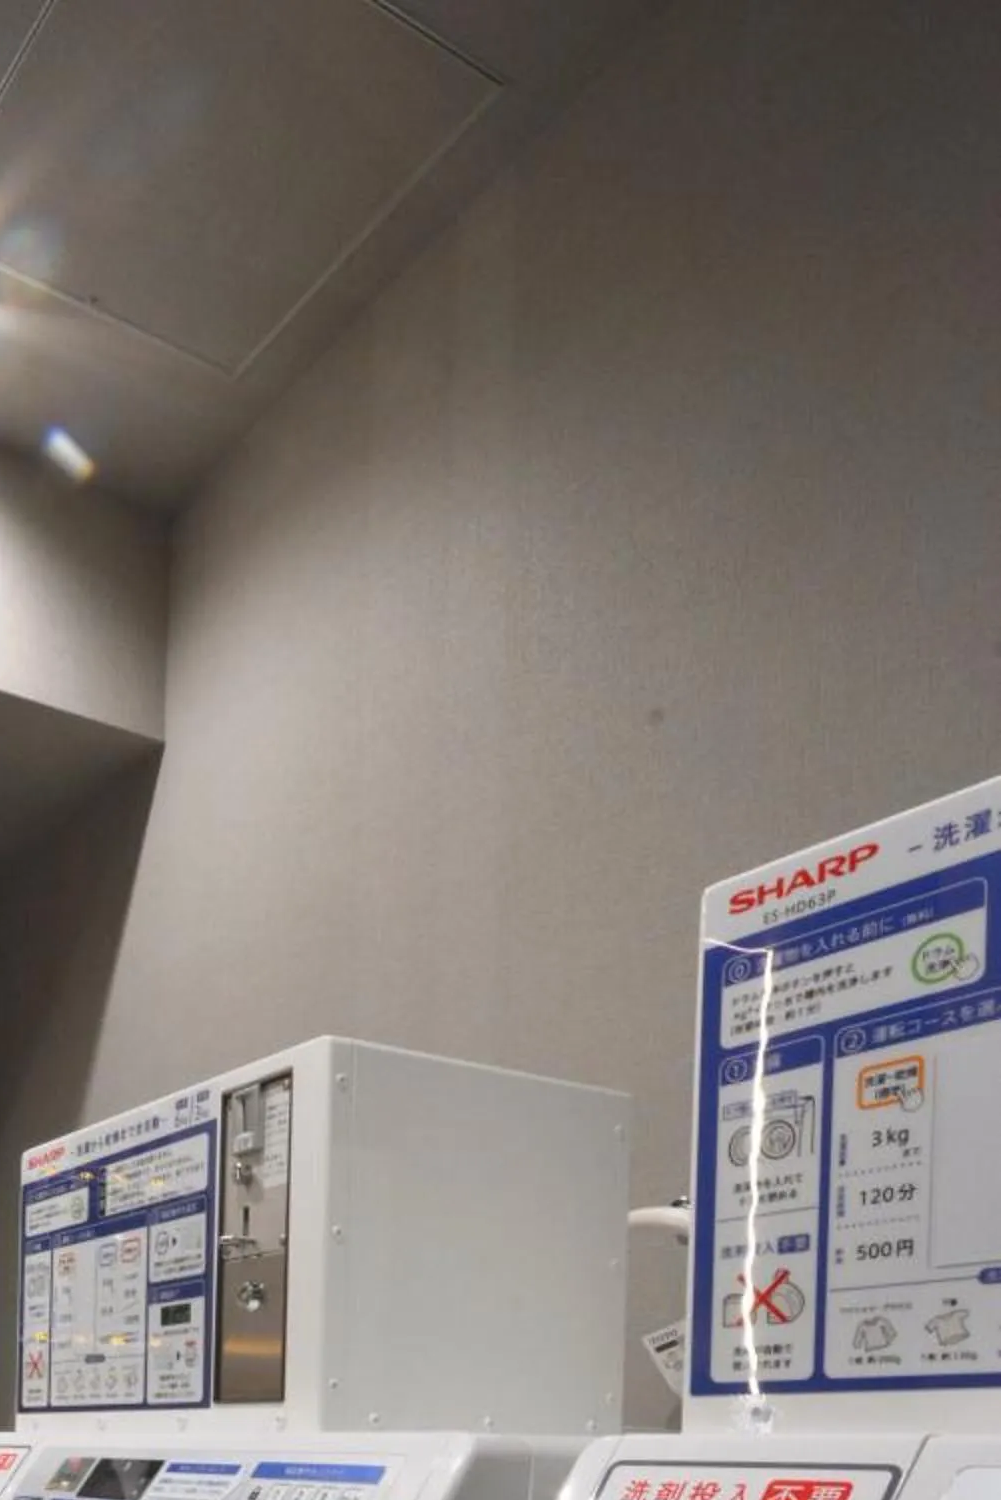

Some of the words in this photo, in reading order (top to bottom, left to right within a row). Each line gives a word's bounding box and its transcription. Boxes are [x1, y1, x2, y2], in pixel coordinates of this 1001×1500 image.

[728, 842, 880, 915] SHARP
[859, 1182, 918, 1207] 120分
[855, 1239, 914, 1262] 500円
